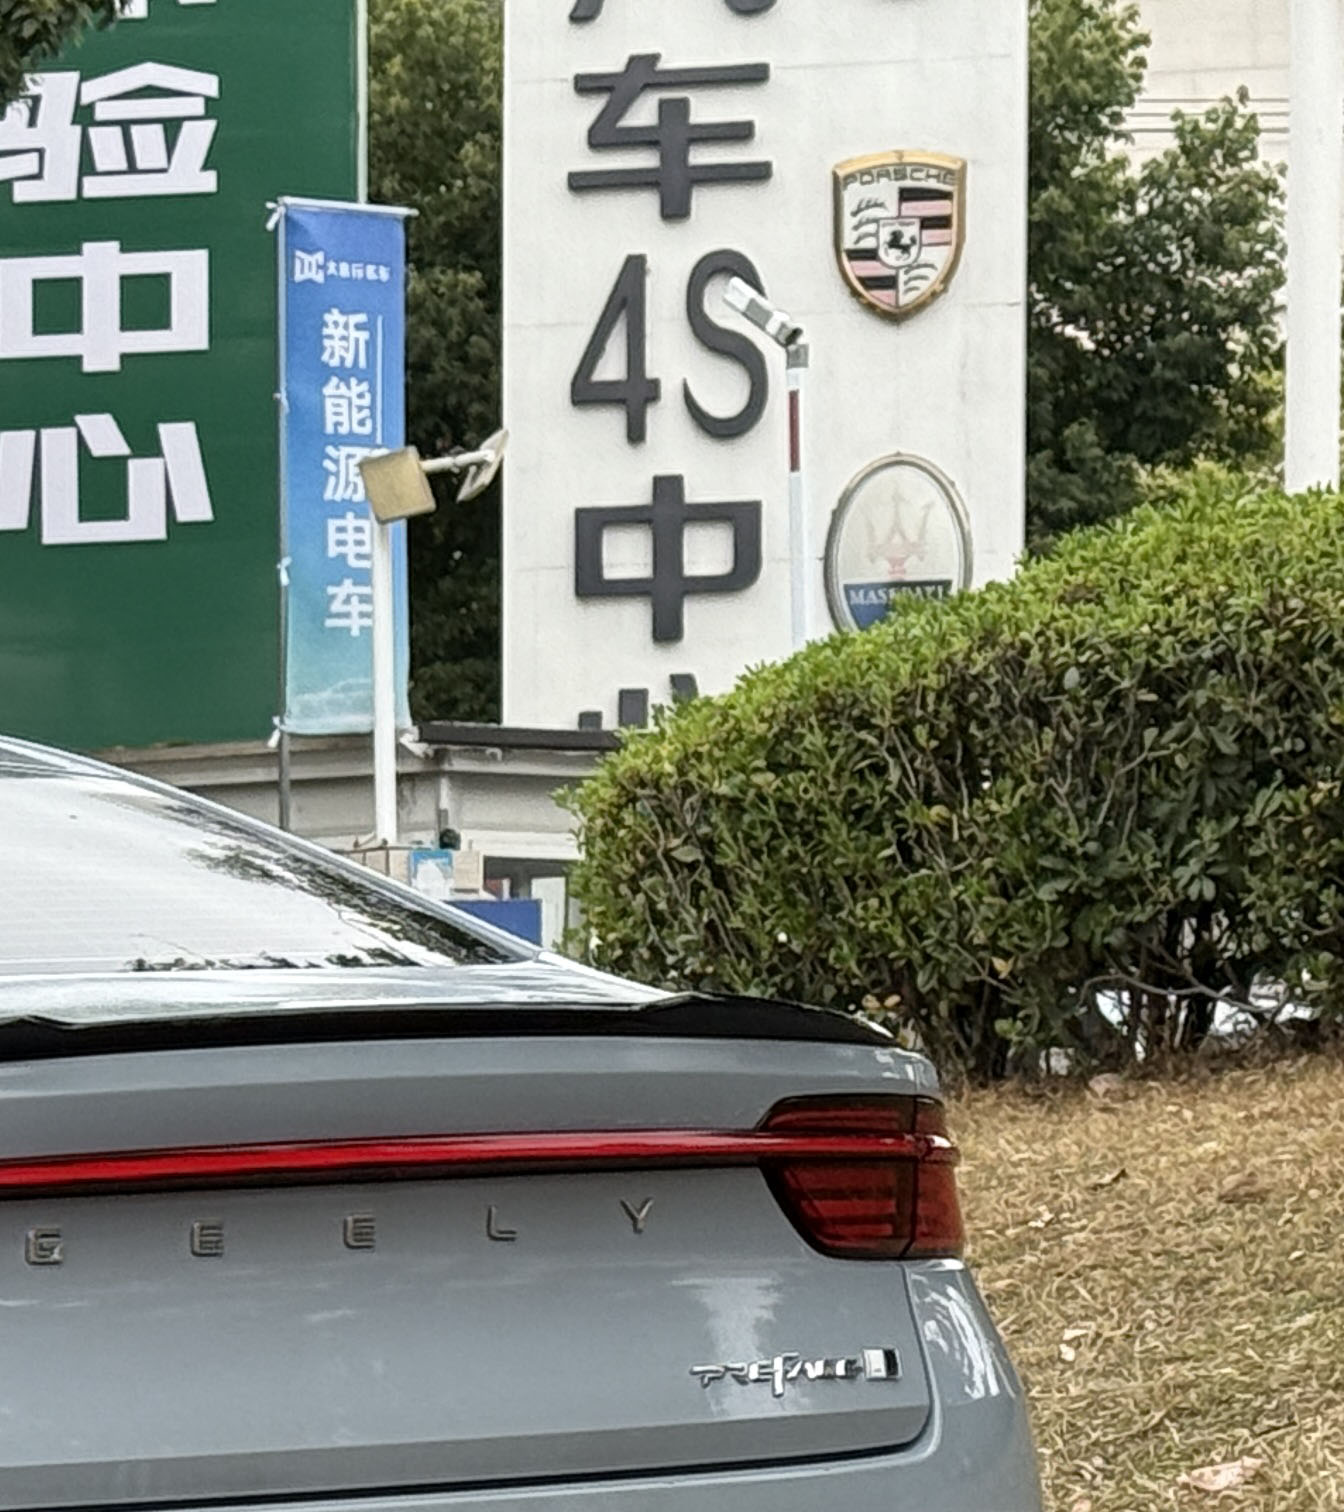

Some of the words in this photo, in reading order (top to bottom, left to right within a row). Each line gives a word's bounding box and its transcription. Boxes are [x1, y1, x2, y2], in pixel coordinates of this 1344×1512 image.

[842, 166, 957, 191] PORSCHE
[568, 0, 775, 728] 车4S中
[321, 308, 374, 637] 新能源电车
[849, 585, 945, 606] MASEATI
[24, 1198, 654, 1266] GEELY
